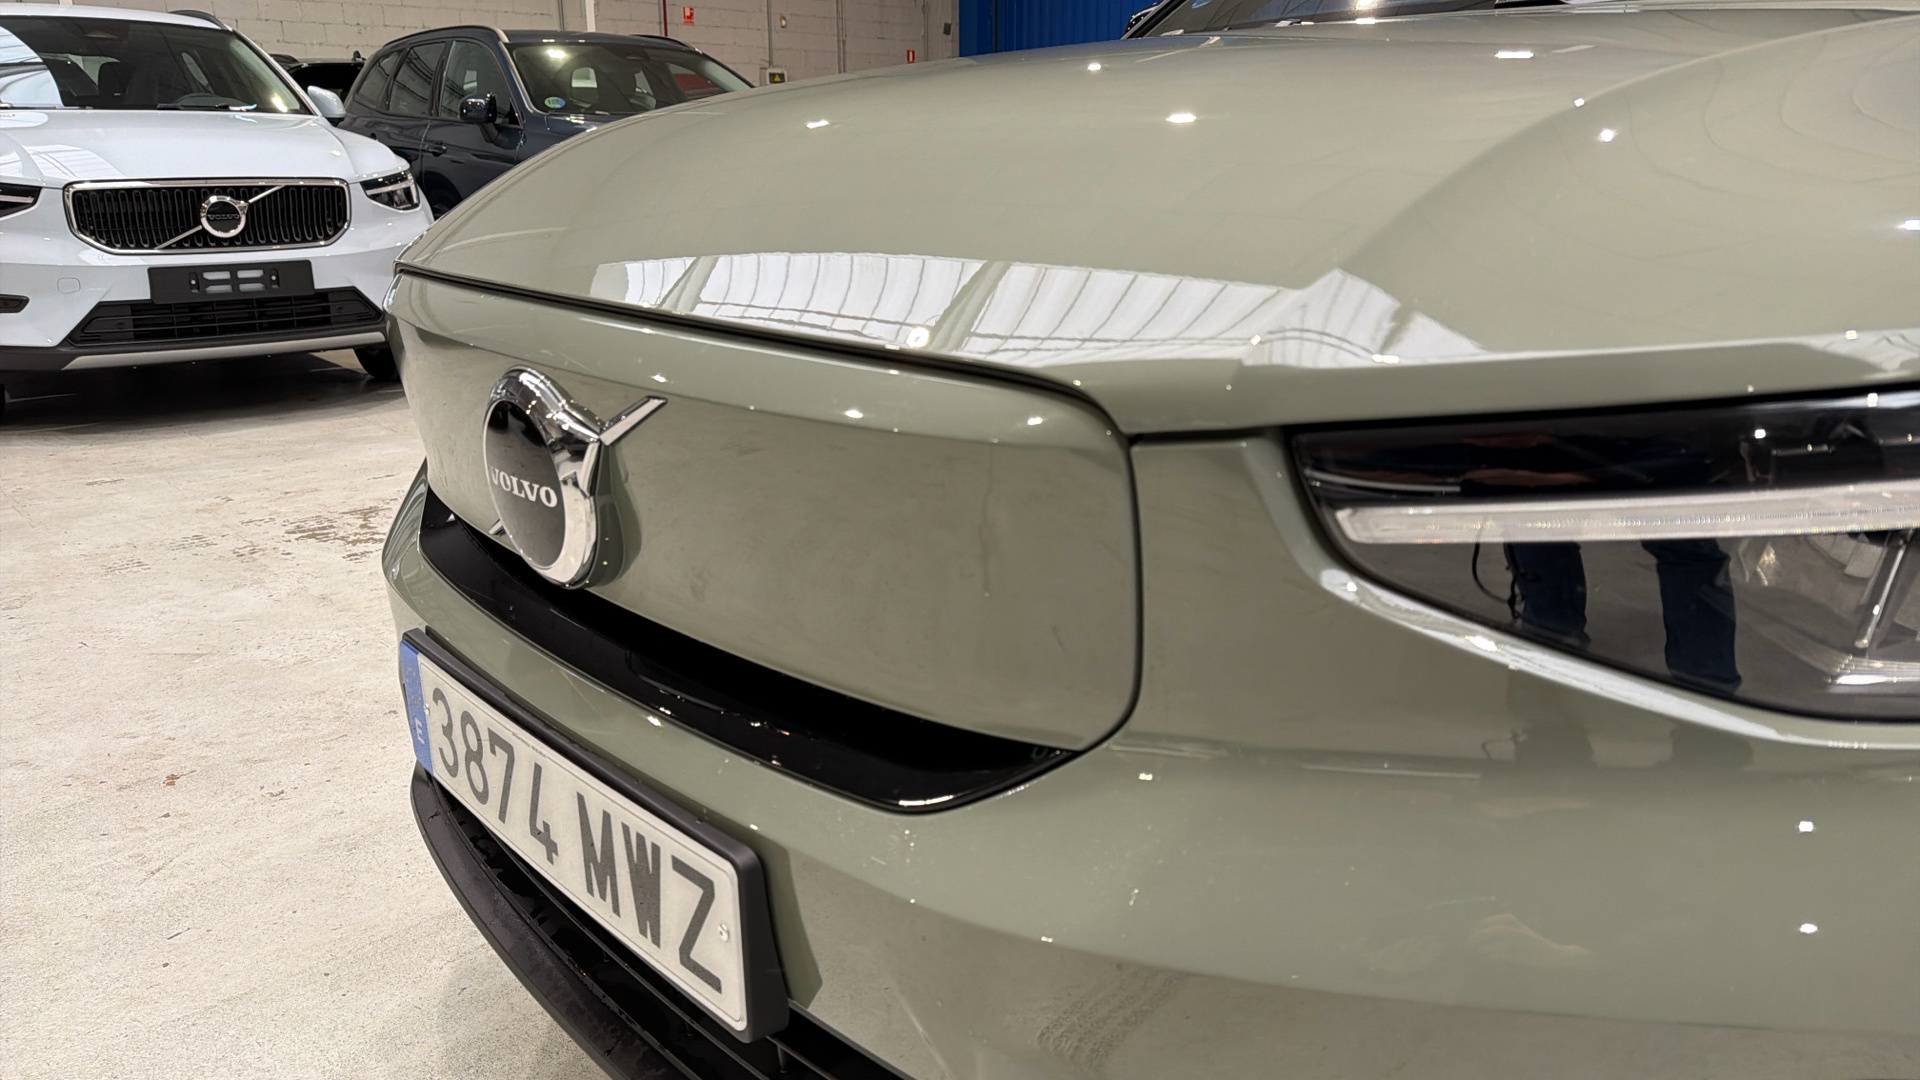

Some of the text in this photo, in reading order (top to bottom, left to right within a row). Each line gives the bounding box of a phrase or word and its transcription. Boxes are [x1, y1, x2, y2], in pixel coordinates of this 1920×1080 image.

[490, 466, 558, 508] VOLVO
[432, 687, 723, 995] 3874 MWZ
